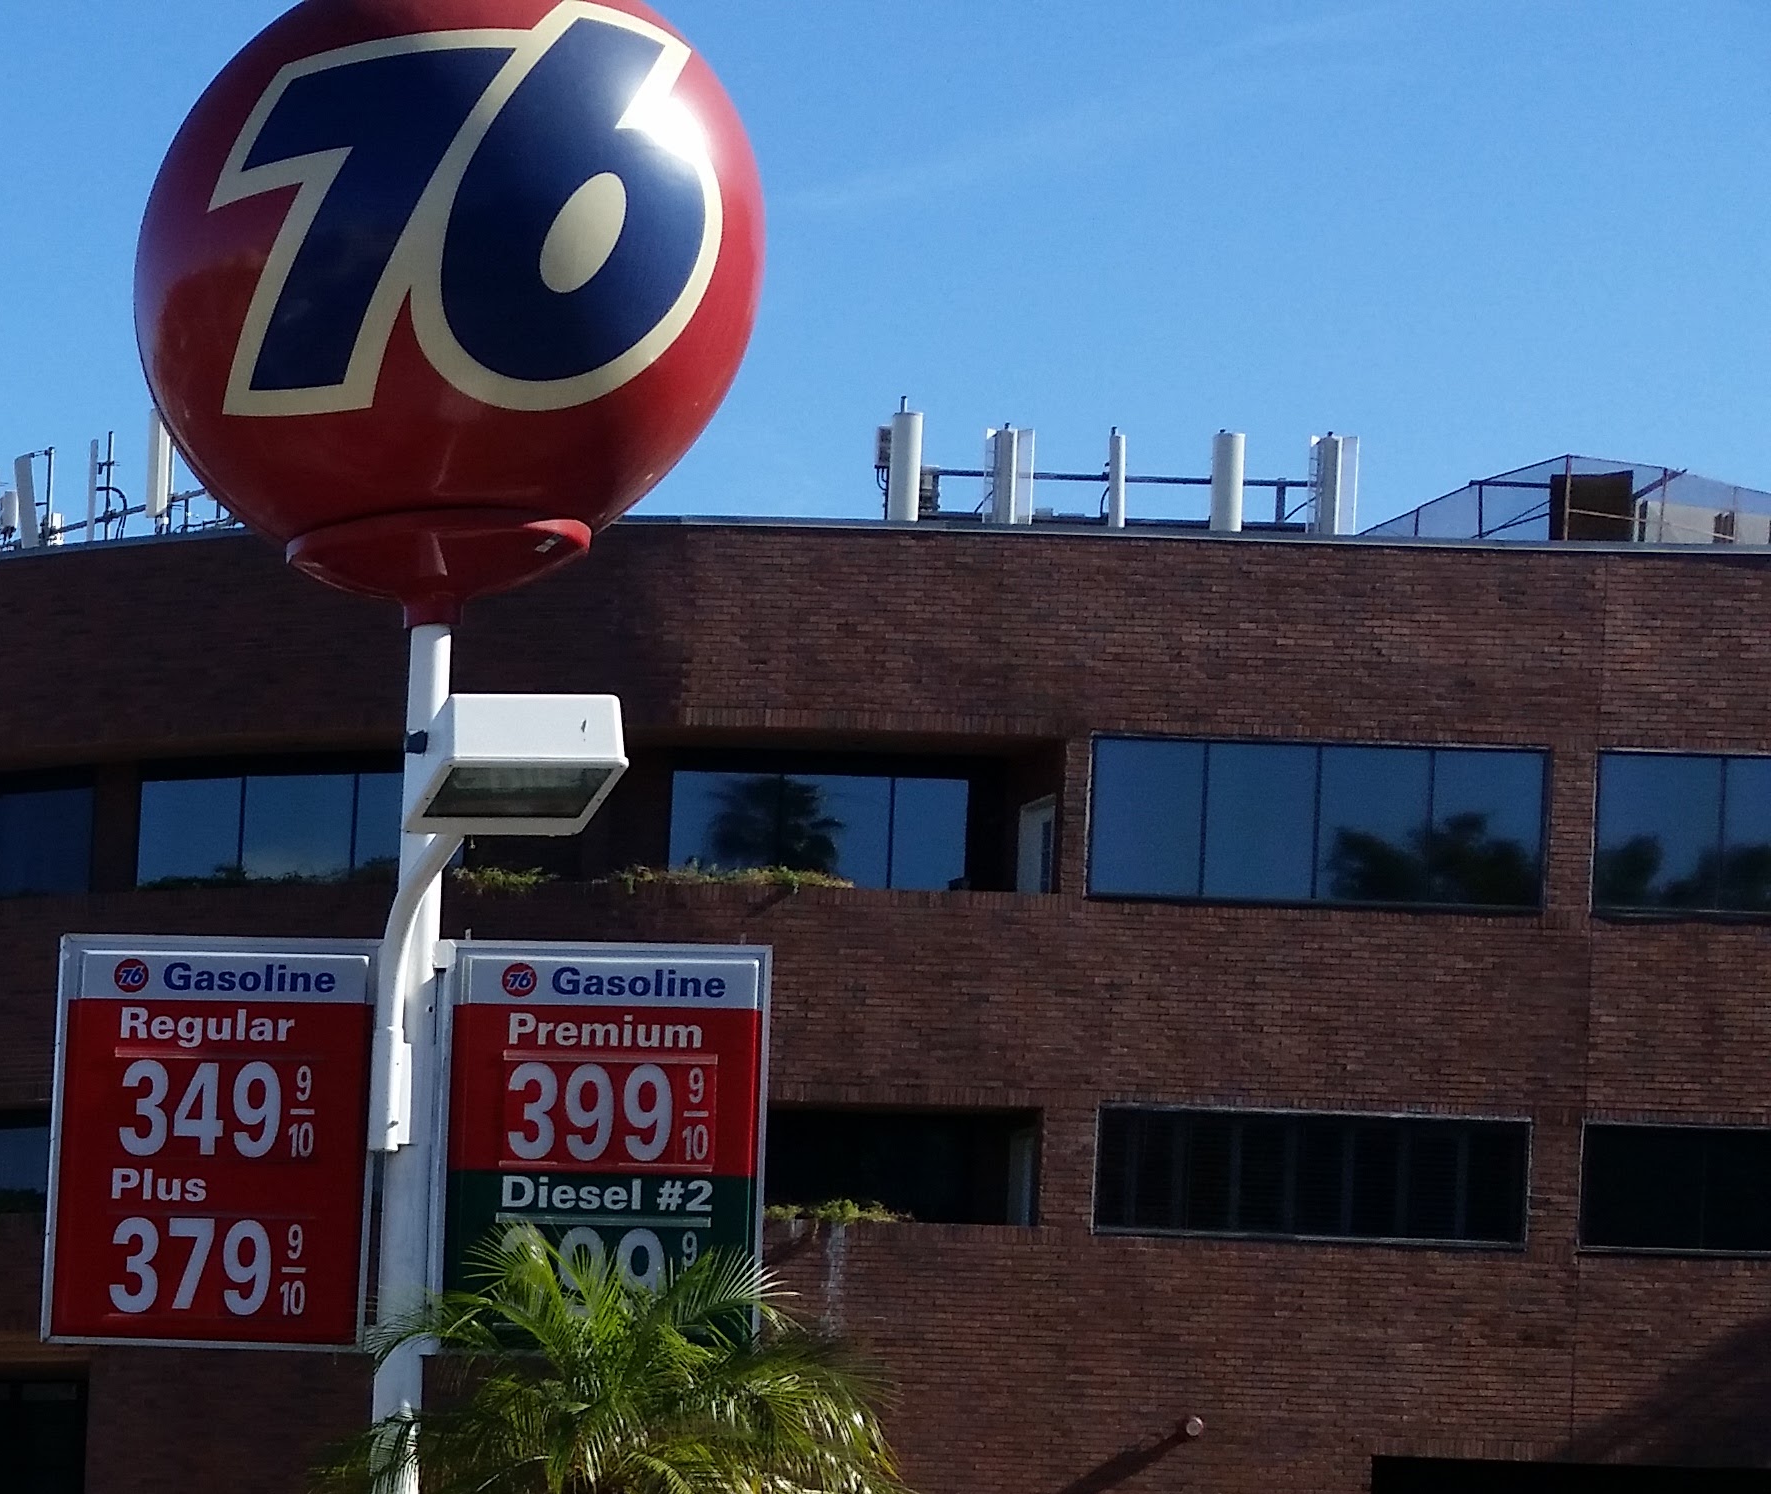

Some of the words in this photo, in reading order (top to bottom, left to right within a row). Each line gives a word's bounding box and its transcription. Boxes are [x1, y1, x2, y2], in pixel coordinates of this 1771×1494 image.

[209, 0, 723, 417] 76
[119, 966, 144, 985] 76
[163, 962, 335, 992] Gasoline
[507, 970, 532, 989] 76
[552, 966, 726, 998] Gasoline
[120, 1006, 295, 1048] Regular
[508, 1012, 702, 1049] Premium
[296, 1065, 312, 1101] 9
[688, 1067, 704, 1103] 9
[119, 1059, 281, 1158] 349
[508, 1061, 673, 1161] 399
[288, 1122, 314, 1158] 10
[682, 1124, 708, 1160] 10
[111, 1168, 207, 1201] Plus
[502, 1175, 642, 1211] Diesel
[657, 1179, 713, 1212] #2
[287, 1224, 303, 1260] 9
[109, 1217, 271, 1316] 379
[280, 1280, 306, 1315] 10
